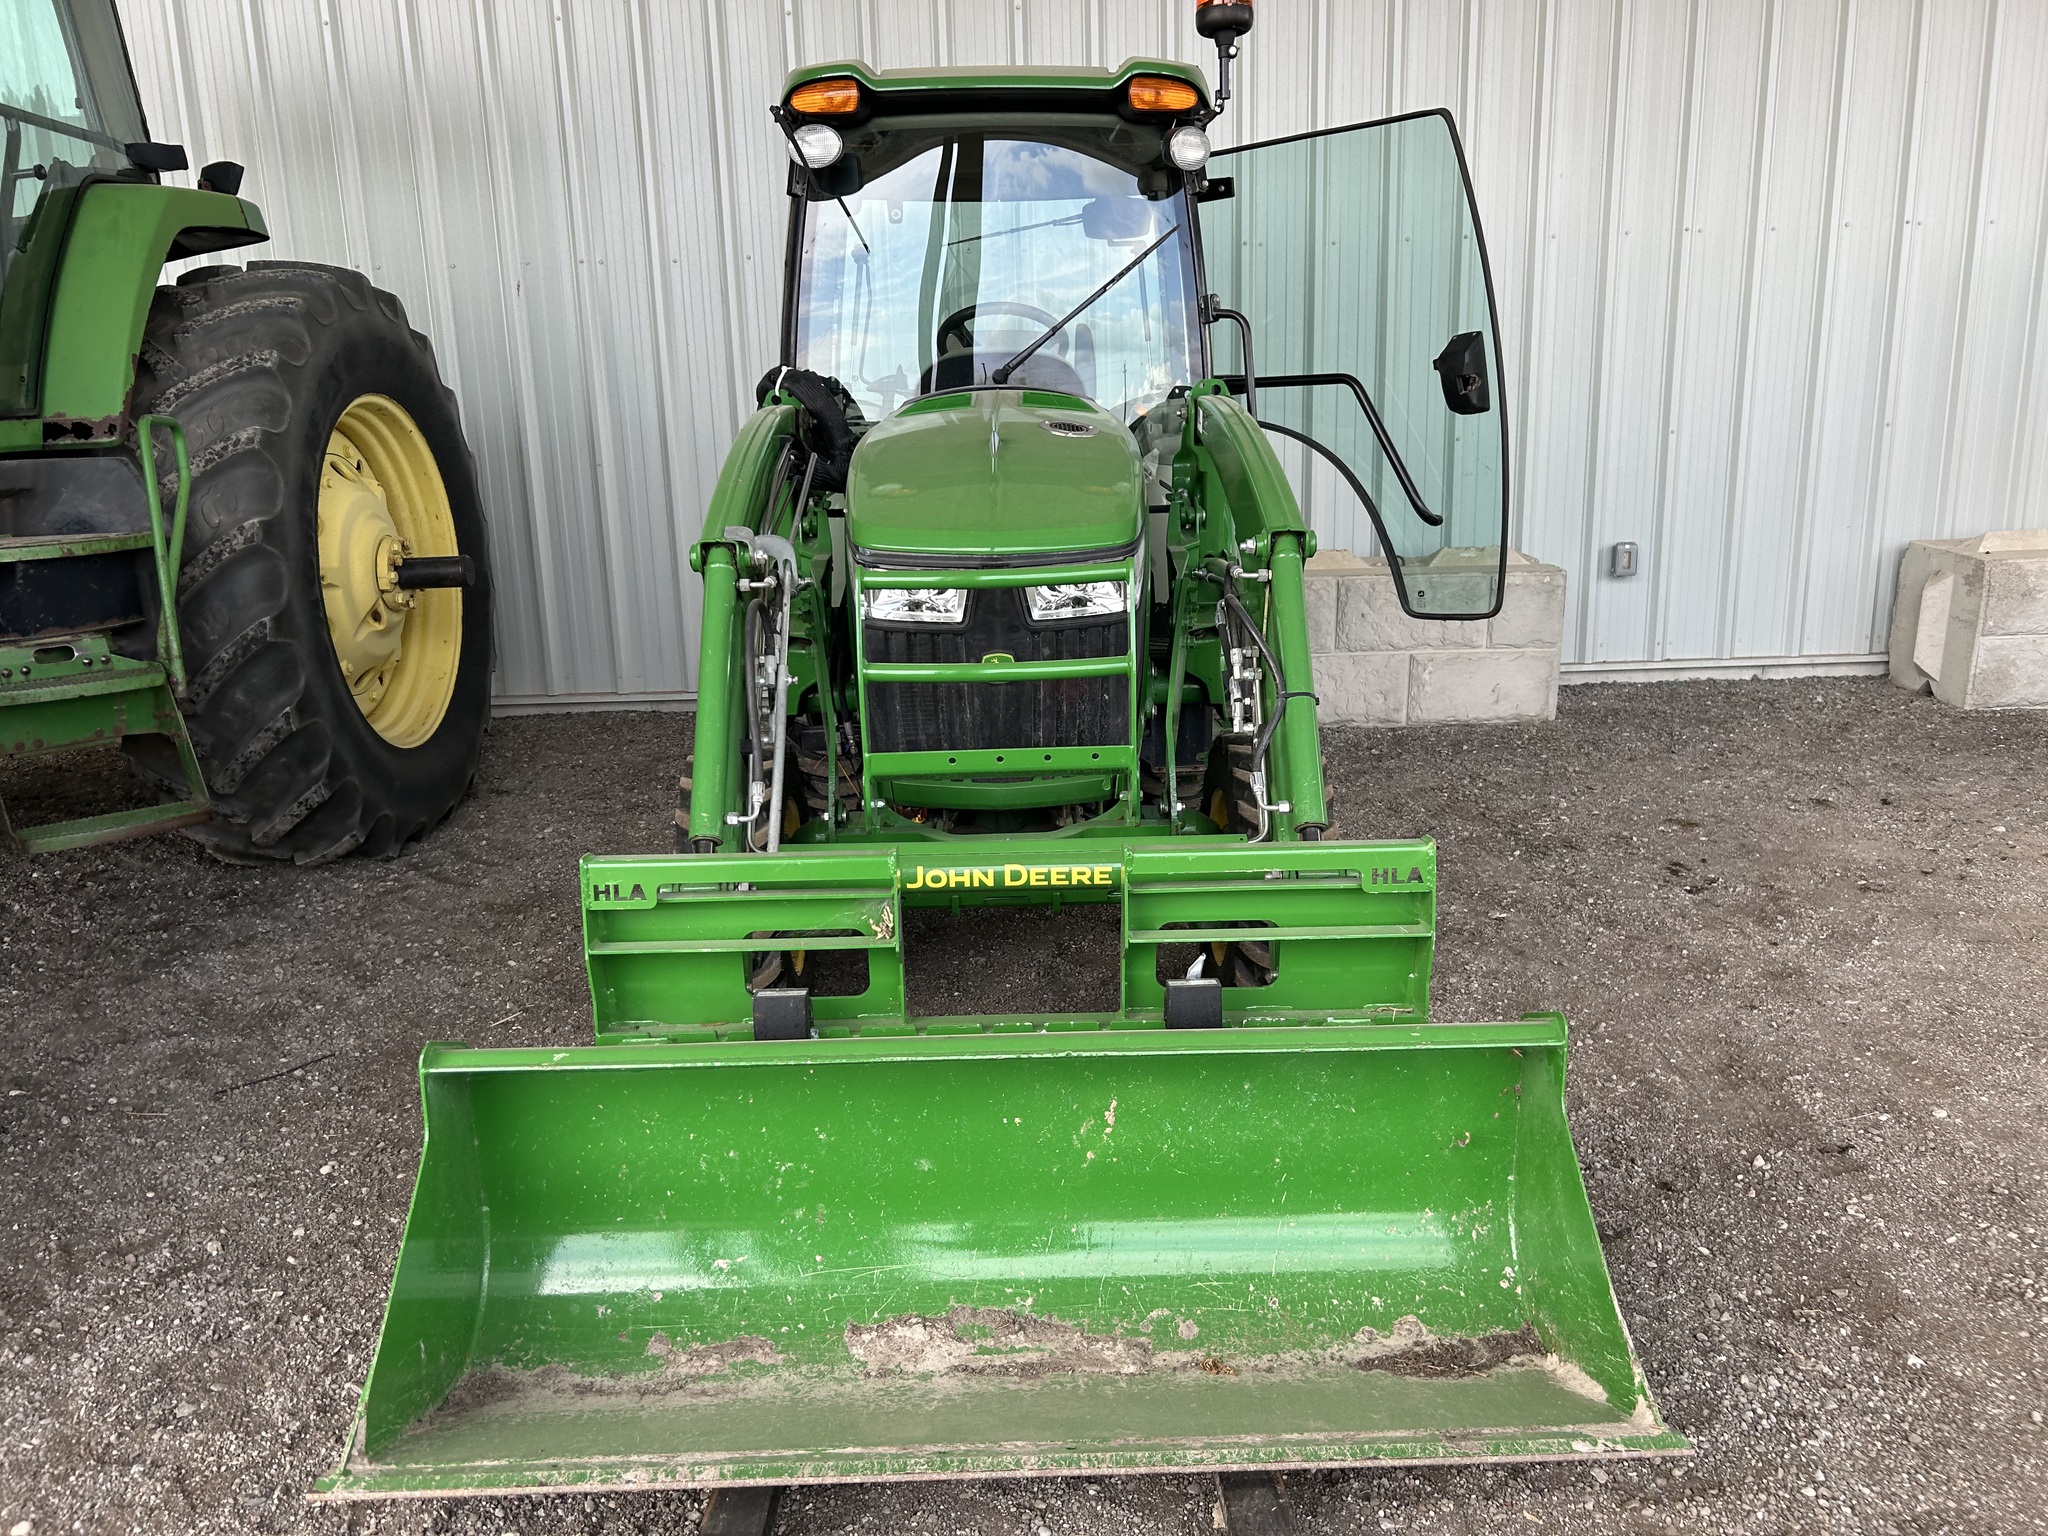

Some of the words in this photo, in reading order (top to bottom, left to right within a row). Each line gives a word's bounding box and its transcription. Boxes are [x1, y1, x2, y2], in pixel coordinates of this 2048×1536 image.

[906, 866, 994, 889] JOHN
[1004, 863, 1113, 887] DEERE
[1371, 866, 1424, 885] HLA
[593, 883, 647, 902] HLA
